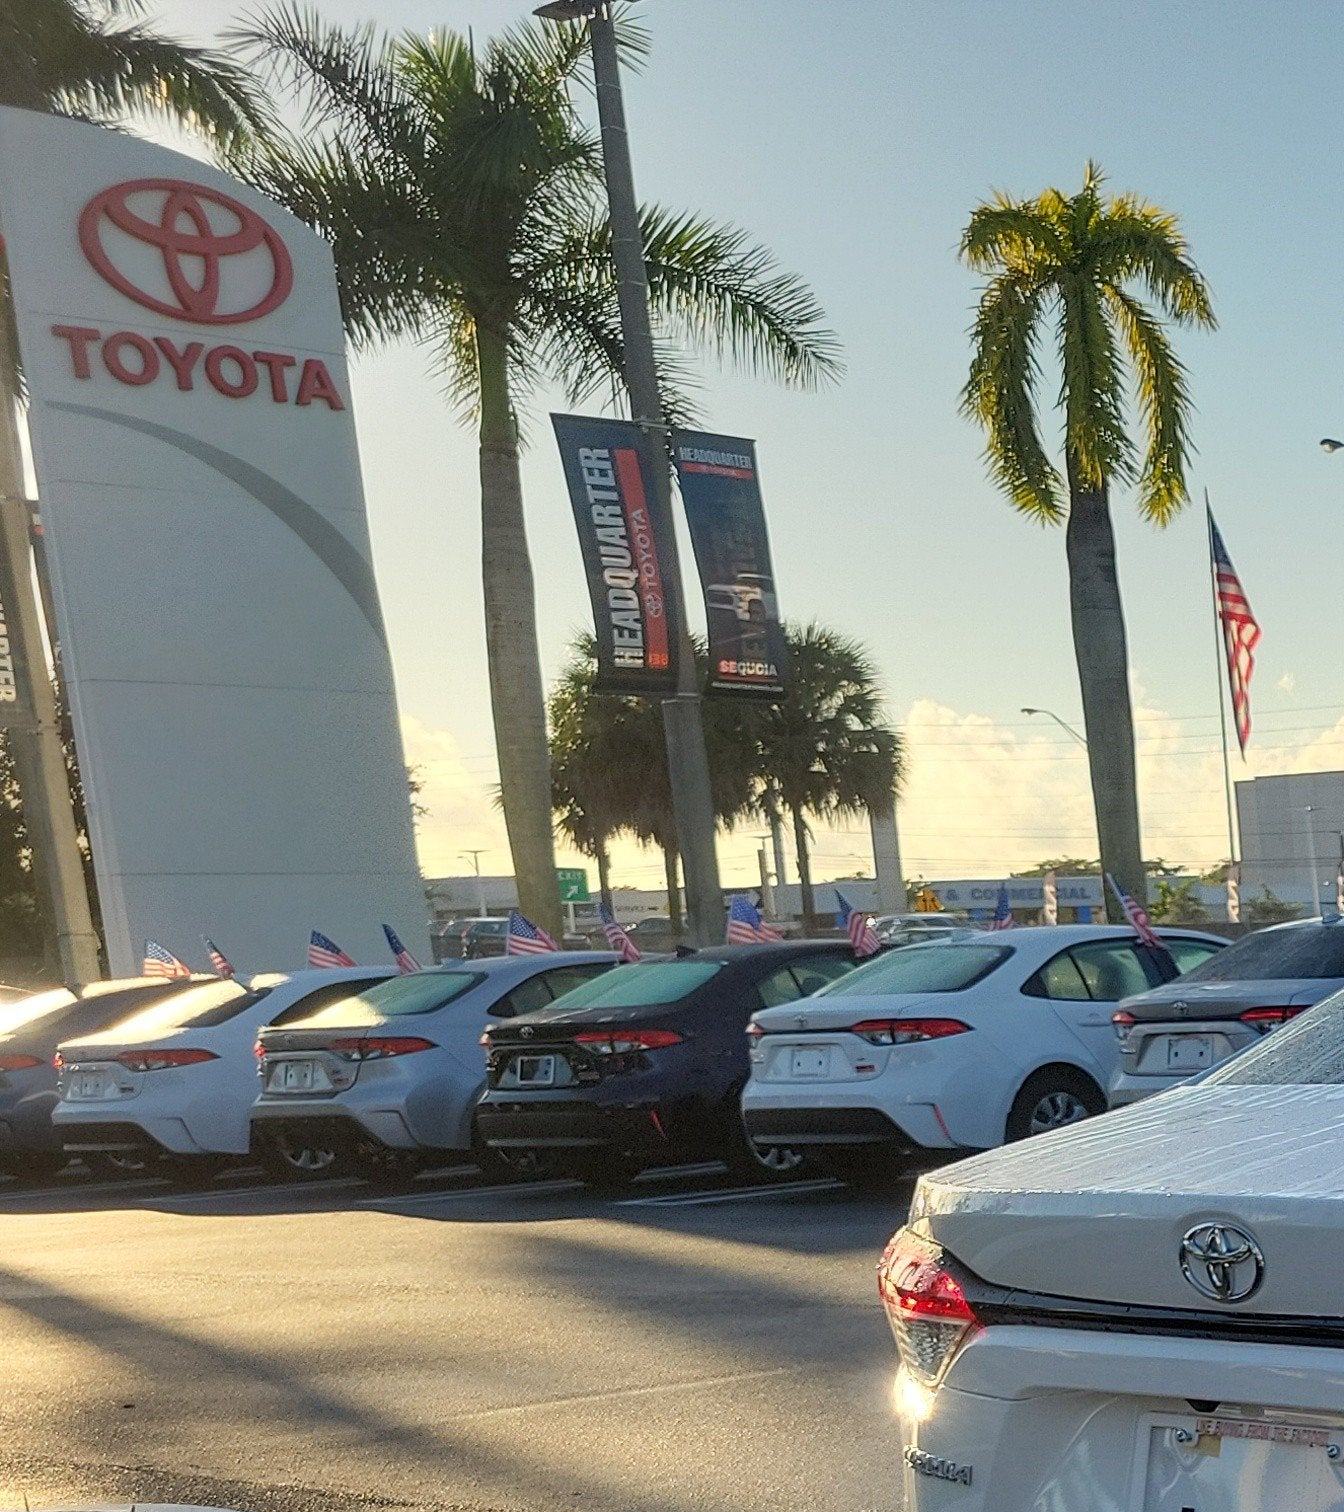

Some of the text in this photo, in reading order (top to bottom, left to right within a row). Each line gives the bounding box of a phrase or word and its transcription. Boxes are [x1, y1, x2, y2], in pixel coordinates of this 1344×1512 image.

[51, 324, 346, 411] TOYOTA
[679, 446, 753, 469] HEADQUARTER
[579, 448, 644, 668] HEADQUARTER
[631, 508, 658, 589] TOYOTA
[720, 660, 778, 677] SEQUOIA
